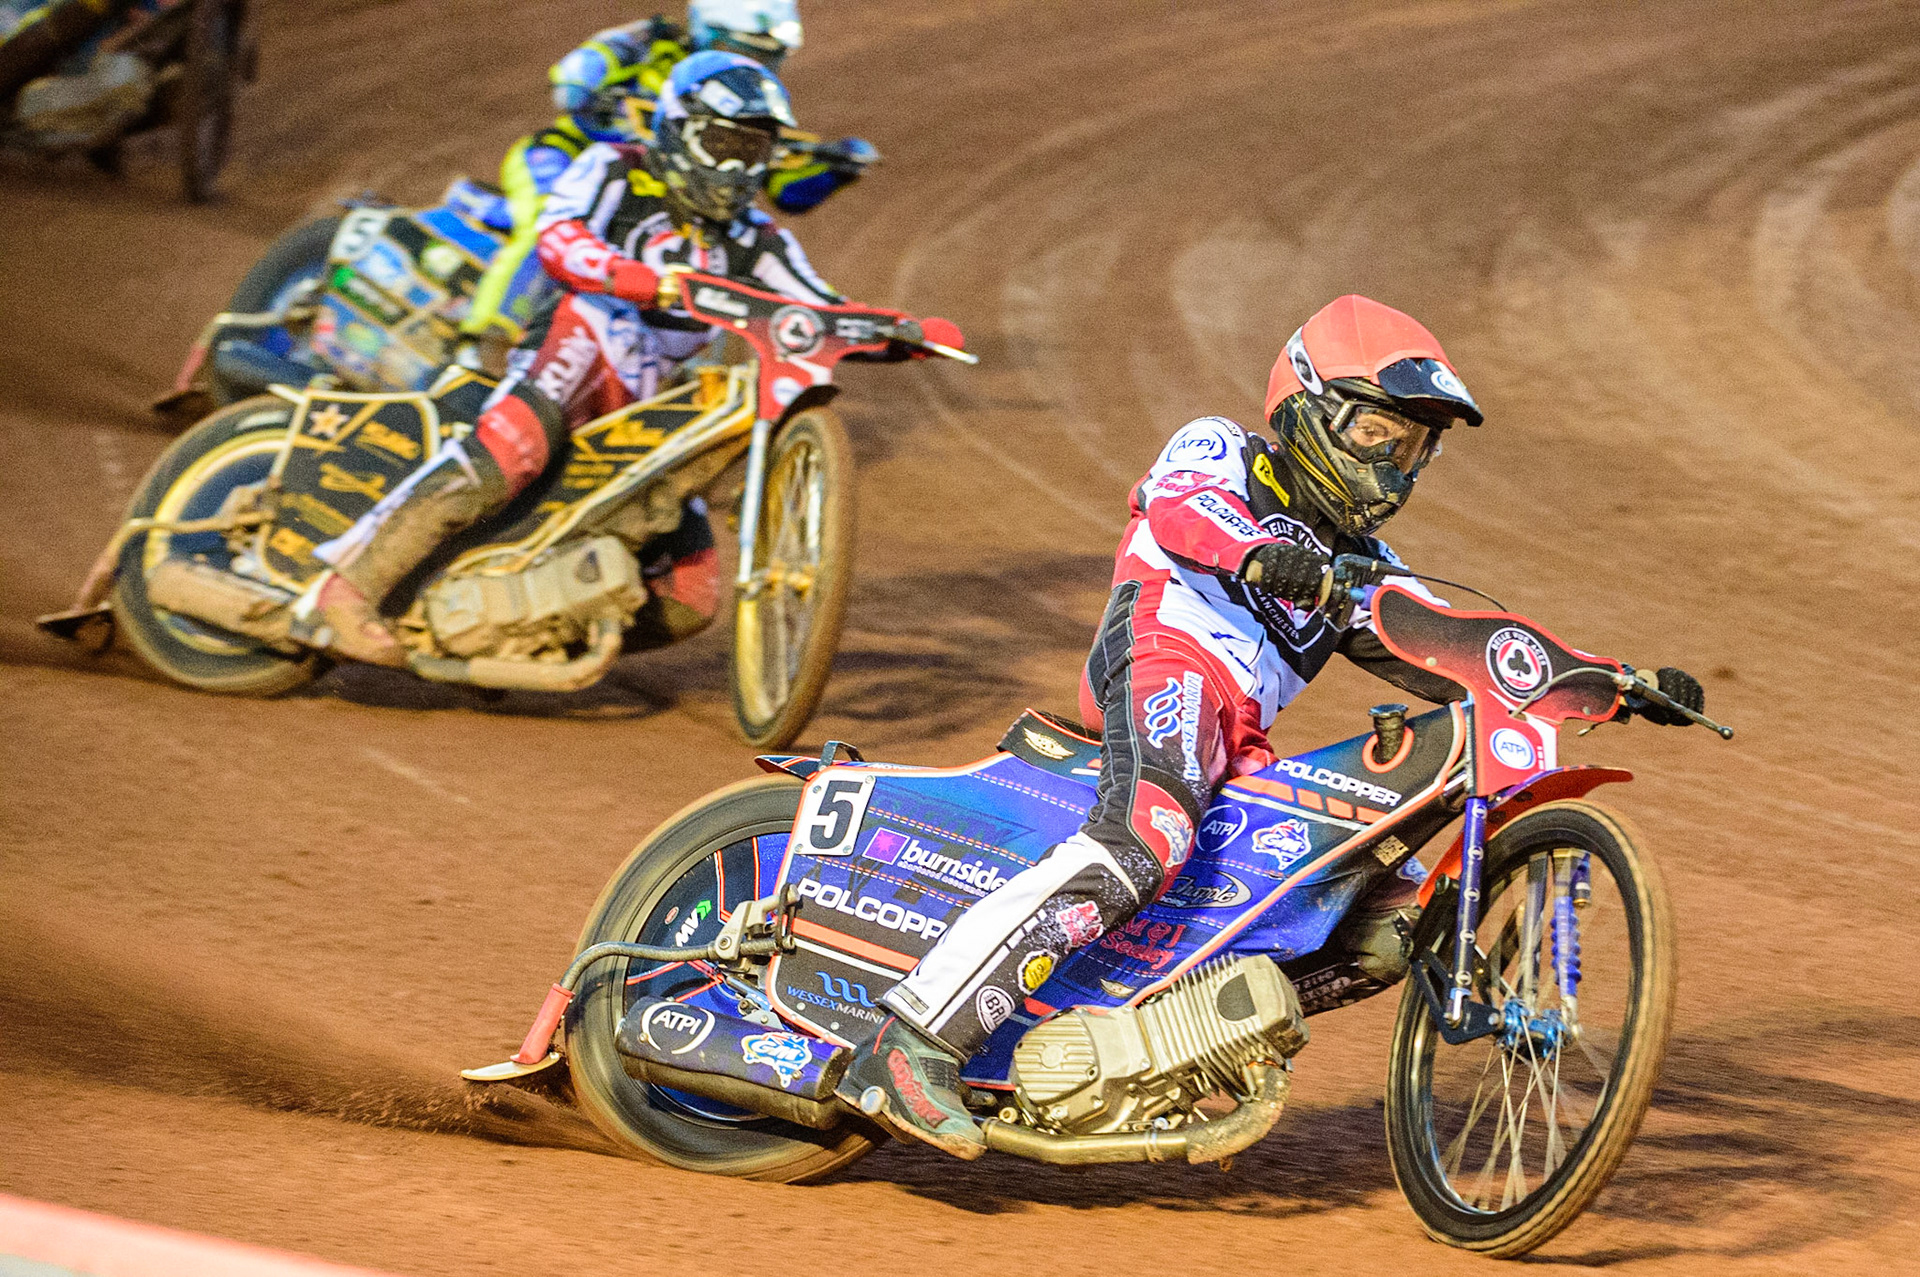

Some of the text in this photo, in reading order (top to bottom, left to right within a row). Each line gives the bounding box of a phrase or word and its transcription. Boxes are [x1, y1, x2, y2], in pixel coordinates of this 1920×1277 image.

[1266, 520, 1294, 538] ELLE
[1491, 631, 1548, 666] BELLE VUE ACES
[1500, 741, 1527, 758] ATPI
[1274, 759, 1402, 807] POLCOPPER
[809, 779, 863, 850] 5
[1202, 819, 1239, 838] ATPI
[651, 1009, 703, 1035] ATPI
